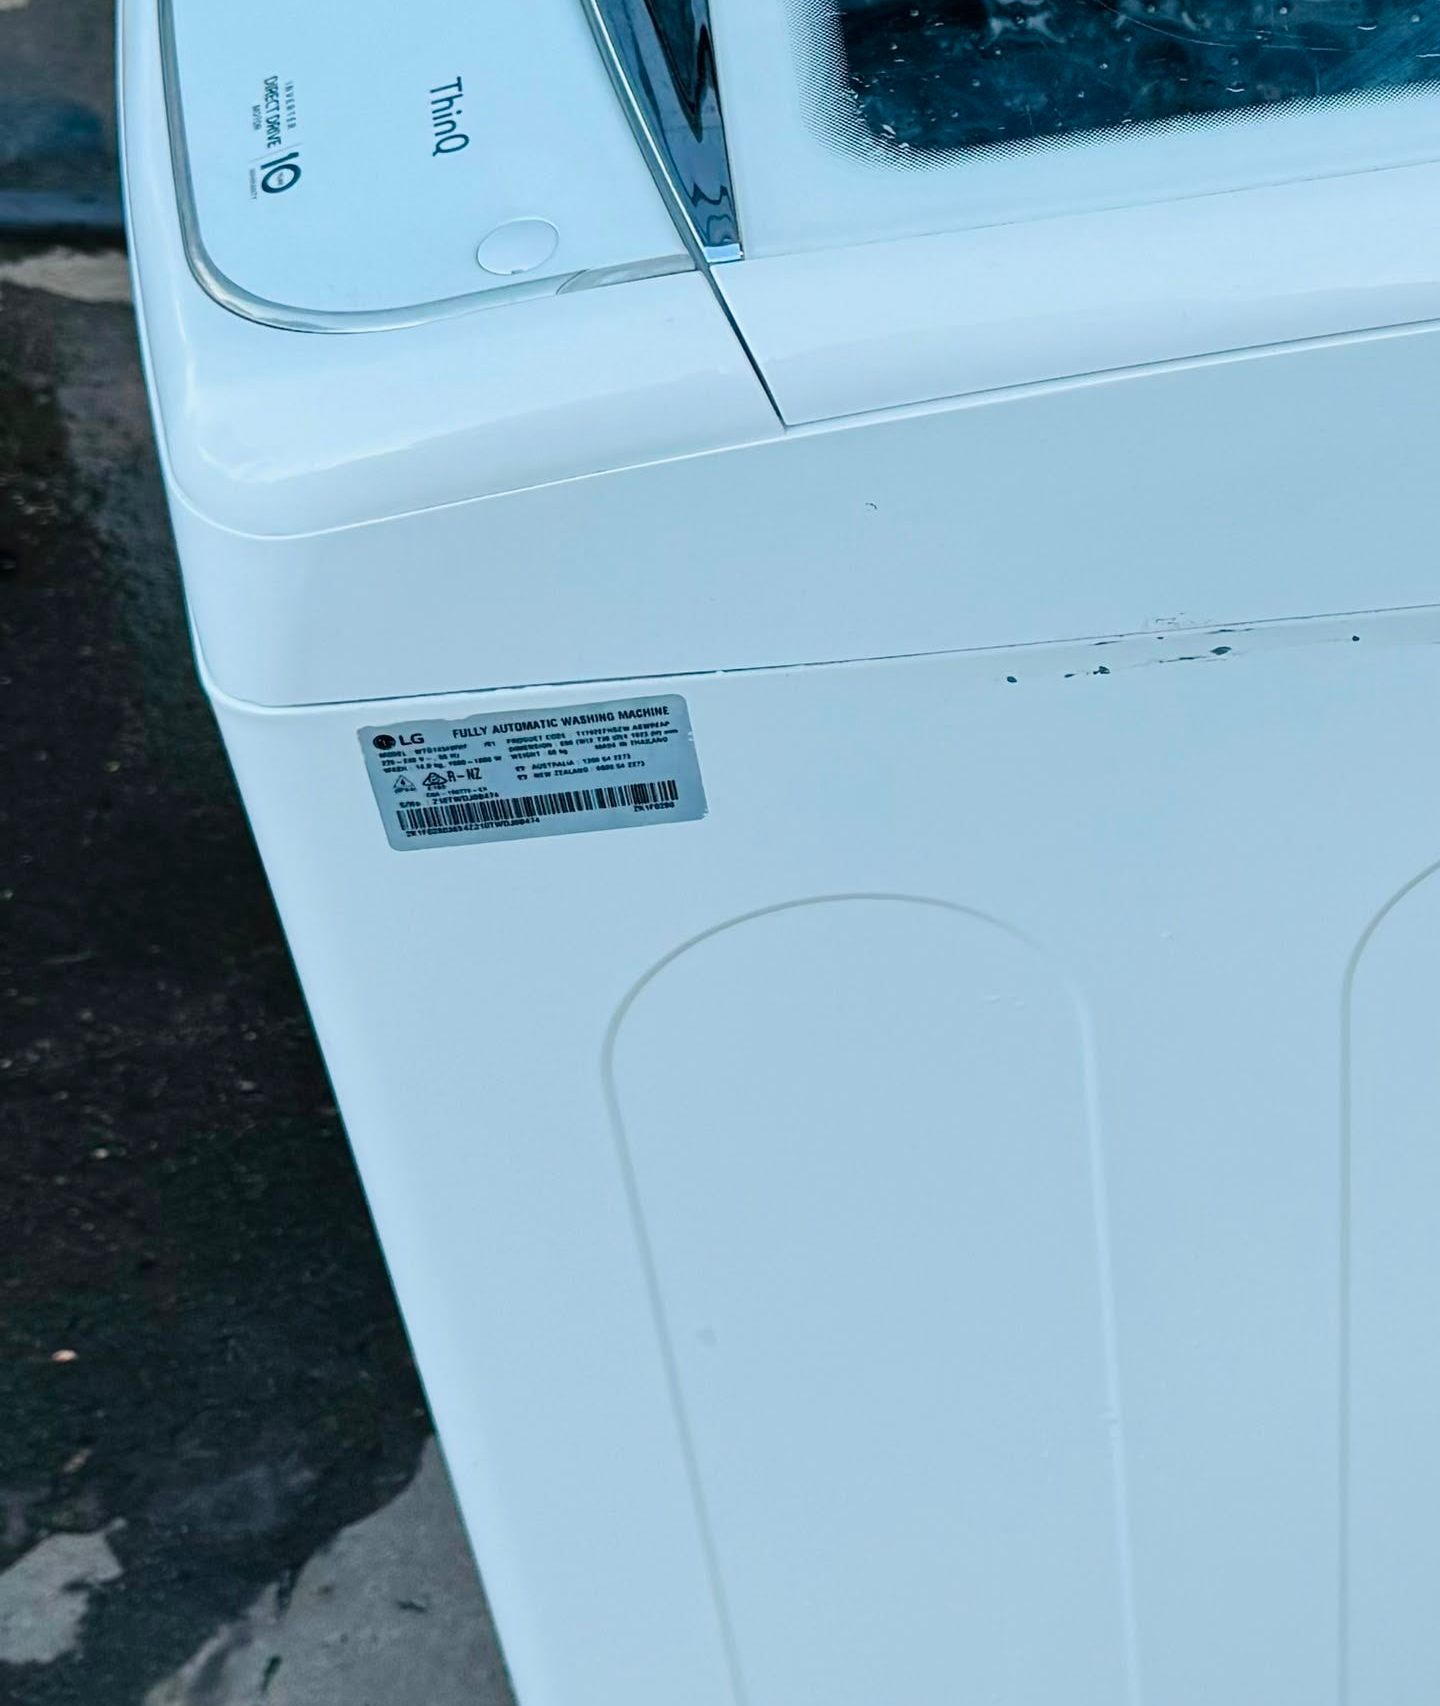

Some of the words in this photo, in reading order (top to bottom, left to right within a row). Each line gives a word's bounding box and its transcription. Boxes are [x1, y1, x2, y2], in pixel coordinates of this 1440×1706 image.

[264, 76, 280, 113] DIRECT
[284, 82, 297, 130] INVERTER
[251, 104, 262, 130] MOTOR
[266, 115, 282, 148] DRIVE
[430, 77, 470, 157] ThinQ
[260, 152, 302, 193] 10
[399, 733, 424, 745] LG
[452, 726, 487, 738] FULLY
[492, 718, 558, 734] AUTOMATIC
[561, 712, 614, 727] WASHING
[618, 706, 670, 720] MACHINE
[532, 760, 574, 770] AUSTRALIA
[554, 767, 589, 776] ZEALAND
